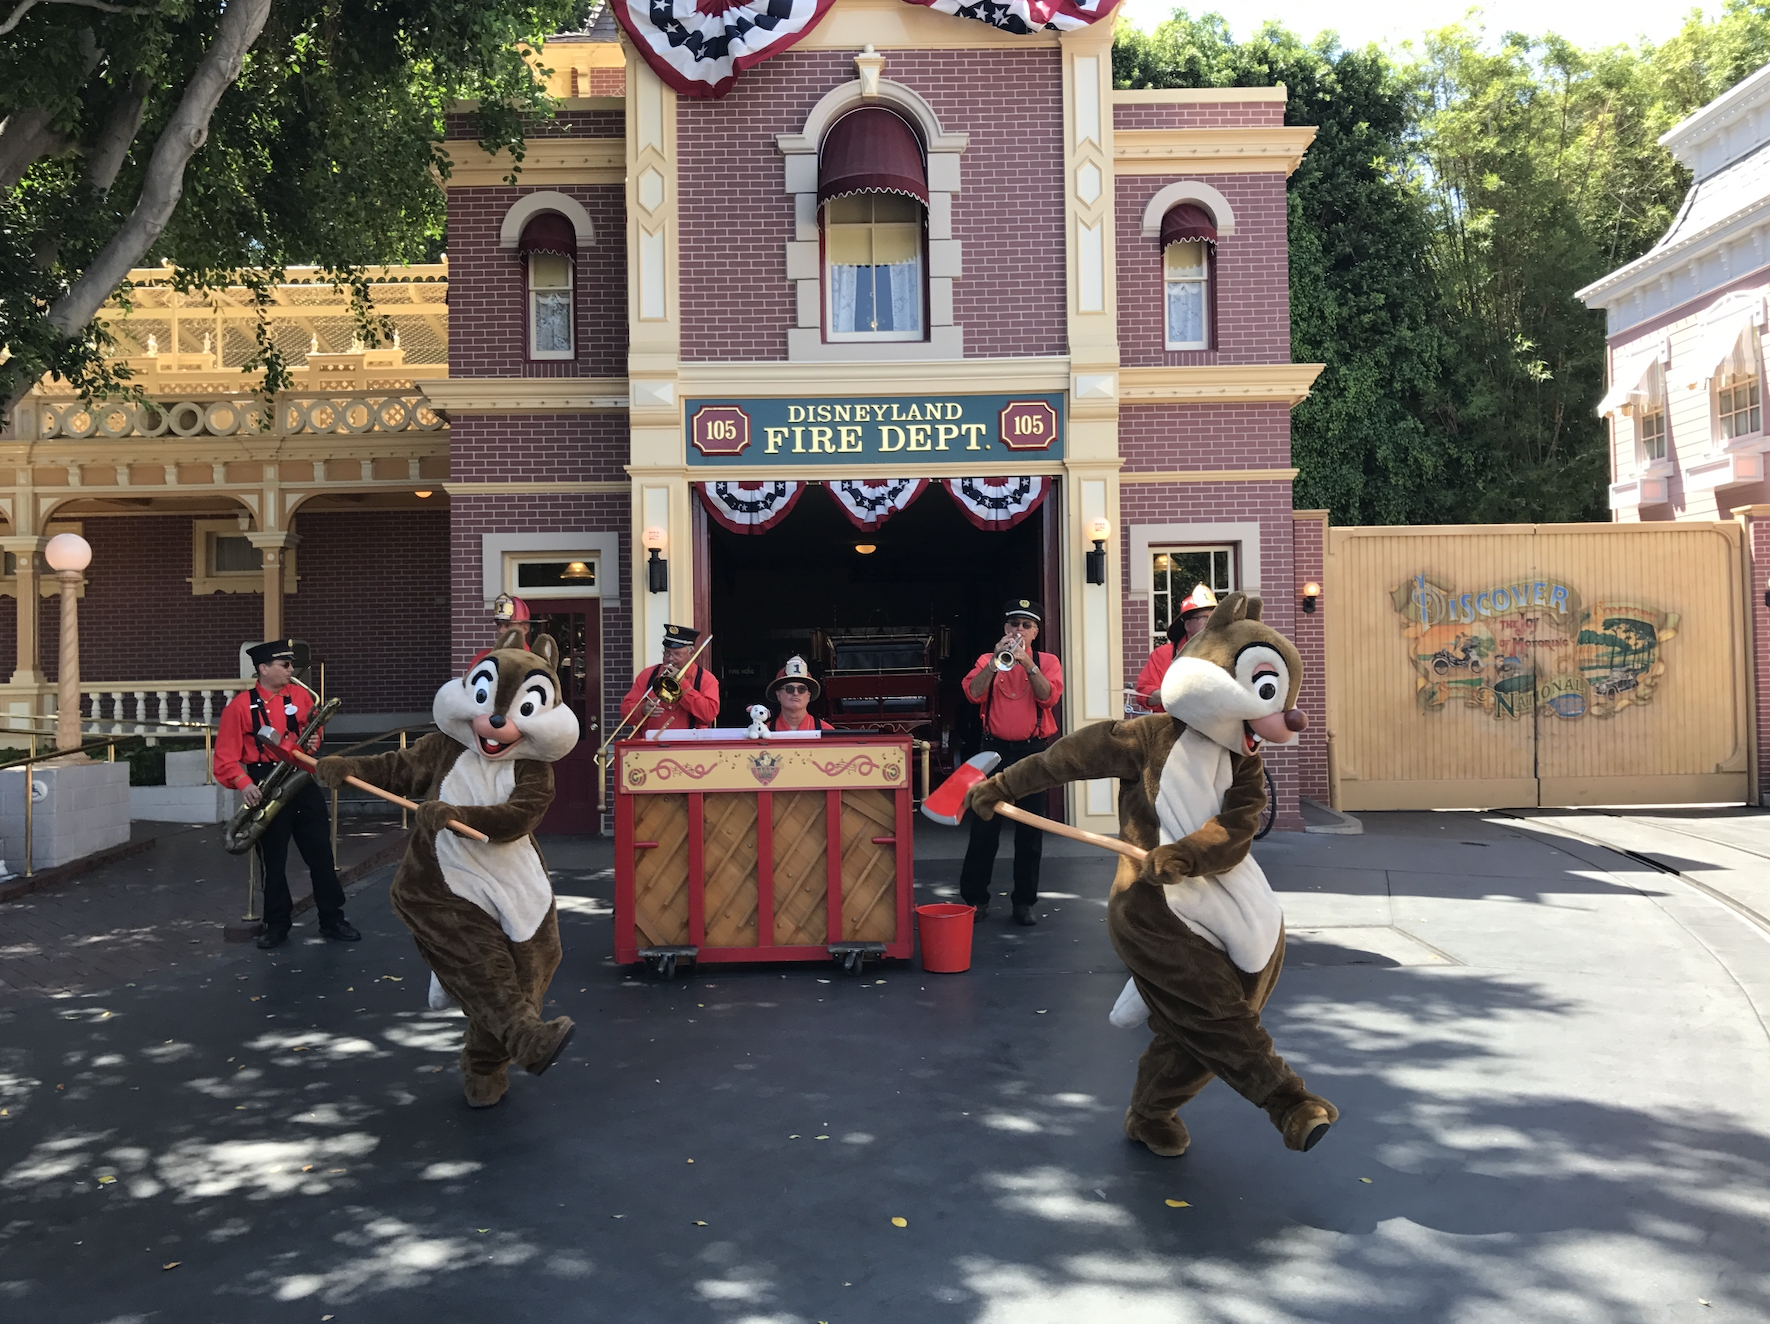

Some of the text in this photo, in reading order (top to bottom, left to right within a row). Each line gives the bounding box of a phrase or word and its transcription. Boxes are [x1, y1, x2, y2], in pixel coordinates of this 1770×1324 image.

[788, 402, 963, 423] DISNEYLAND
[706, 420, 737, 440] 105
[1013, 415, 1044, 435] 105
[764, 423, 991, 454] FIRE DEPT.
[498, 603, 505, 613] 1
[1411, 572, 1572, 632] DISCOVER
[1499, 613, 1540, 636] THE JOY
[1509, 637, 1568, 657] MOTORING
[793, 664, 801, 674] 1
[1479, 678, 1586, 720] NATIONAL
